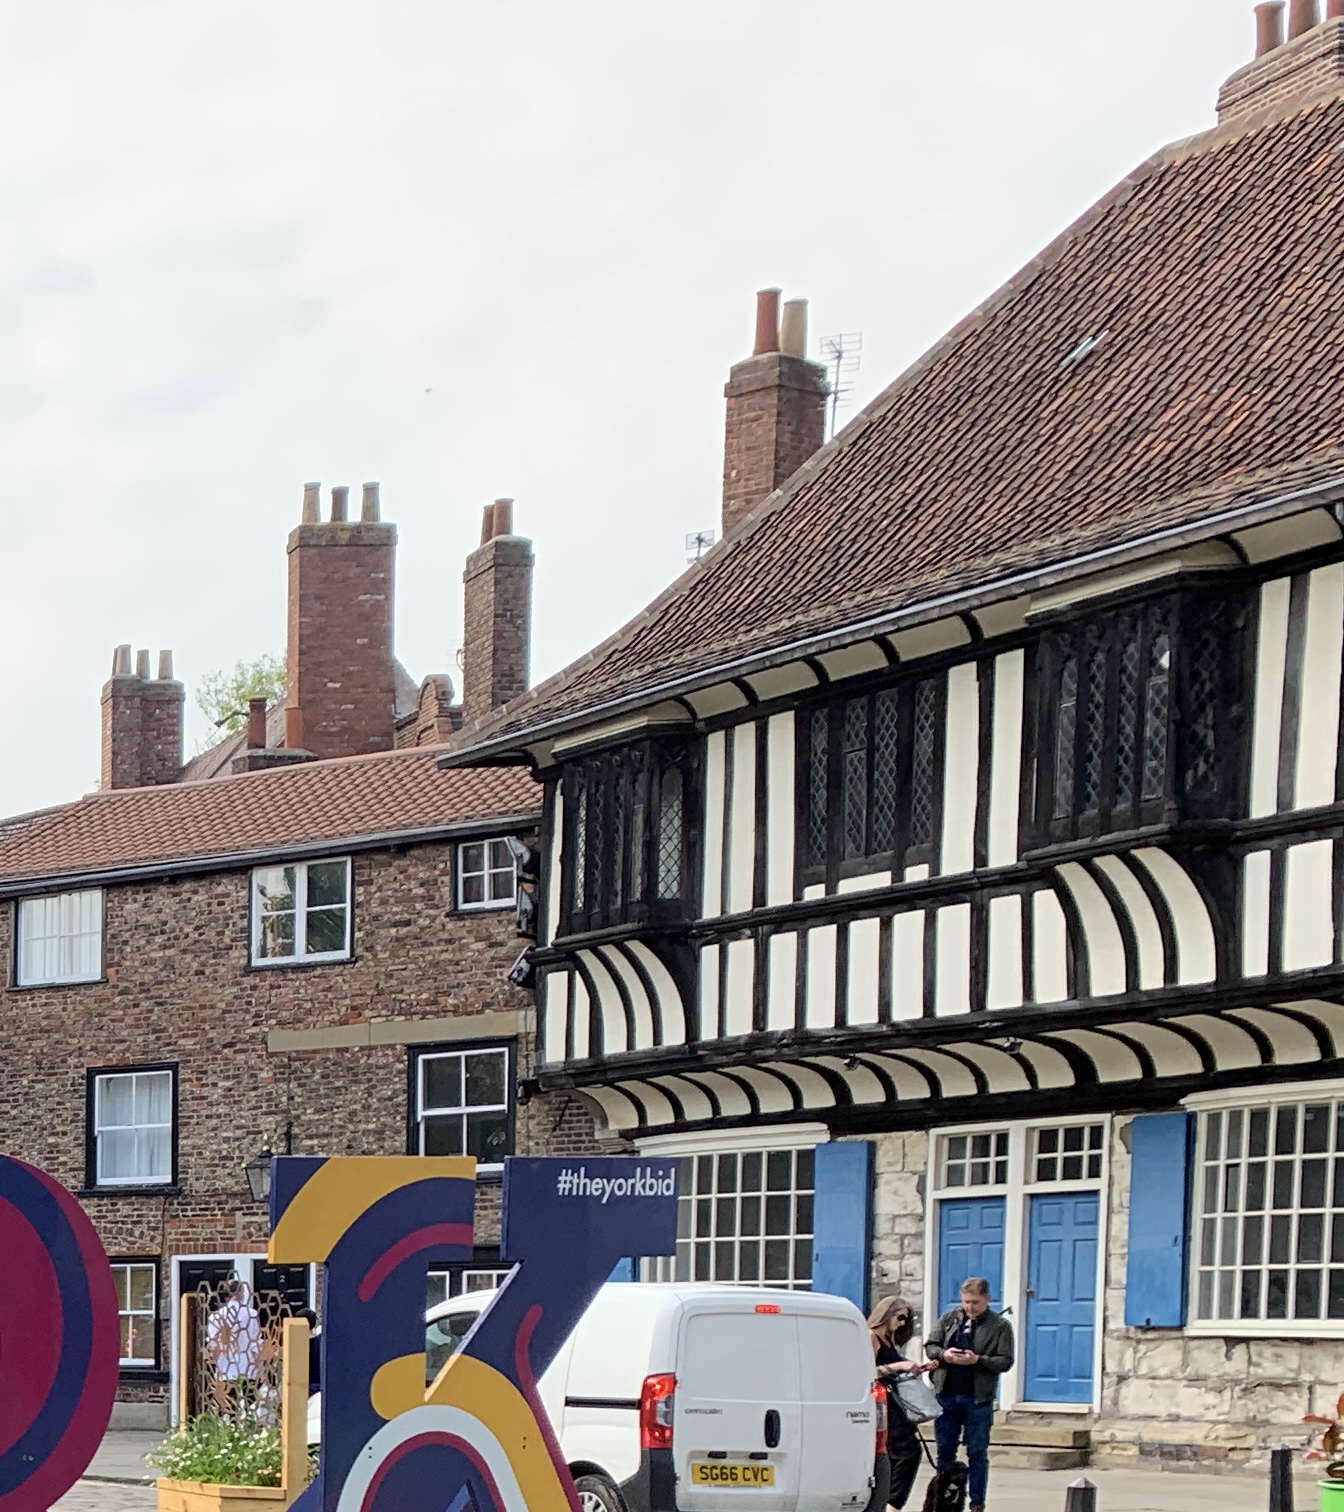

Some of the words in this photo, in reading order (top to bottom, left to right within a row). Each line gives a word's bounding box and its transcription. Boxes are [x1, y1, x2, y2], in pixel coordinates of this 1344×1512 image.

[556, 1166, 676, 1204] #theyorkbid
[699, 1465, 739, 1482] SG66
[742, 1466, 770, 1482] CVC
